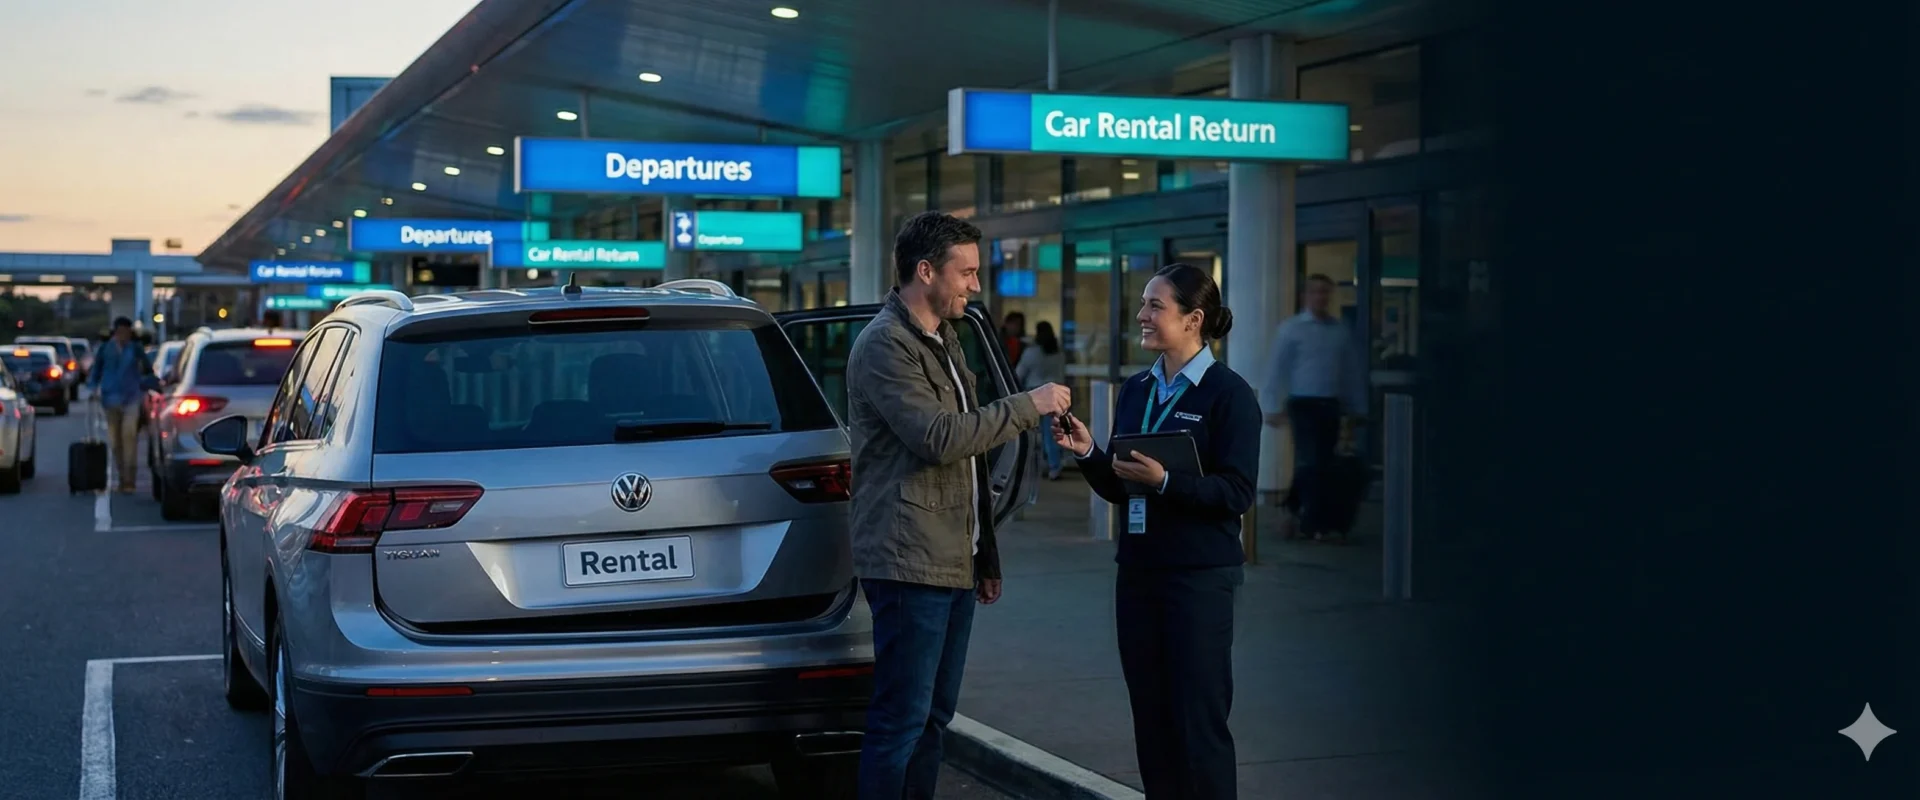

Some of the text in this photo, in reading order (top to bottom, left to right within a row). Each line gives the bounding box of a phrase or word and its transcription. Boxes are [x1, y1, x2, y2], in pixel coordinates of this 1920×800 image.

[1045, 110, 1276, 143] Car Rental Return
[605, 152, 752, 185] Departures
[401, 226, 493, 247] Departures
[528, 247, 639, 262] Car Rental Return
[257, 265, 275, 278] Car
[383, 549, 440, 560] TIGUAN
[580, 545, 677, 576] Rental
